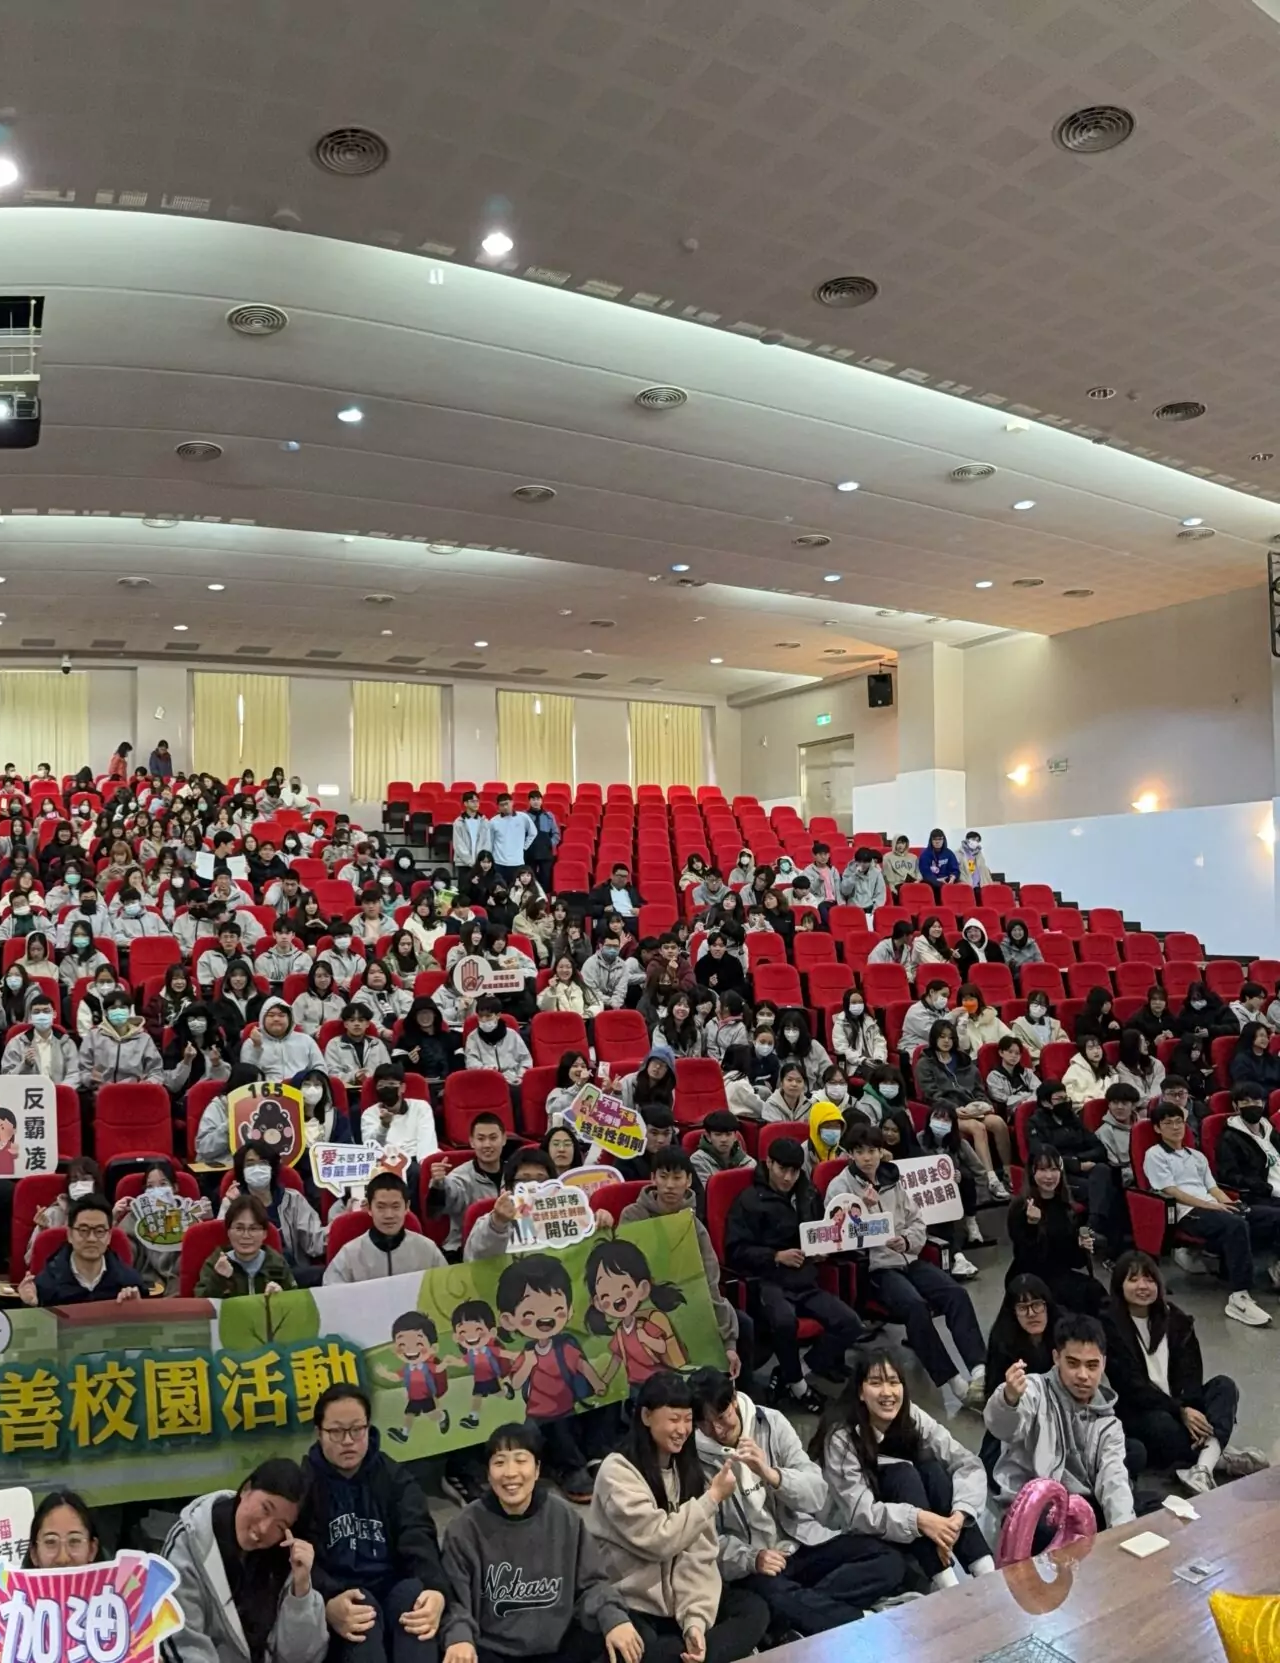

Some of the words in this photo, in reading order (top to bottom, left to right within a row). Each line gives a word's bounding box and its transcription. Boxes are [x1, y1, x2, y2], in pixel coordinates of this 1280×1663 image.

[248, 1083, 283, 1098] 165
[23, 1087, 47, 1171] 反霸凌
[321, 1149, 376, 1166] 愛不是交易
[321, 1163, 370, 1178] 尊嚴無價
[535, 1194, 580, 1211] 性別平等
[545, 1218, 578, 1240] 開始
[0, 1585, 131, 1663] 加油
